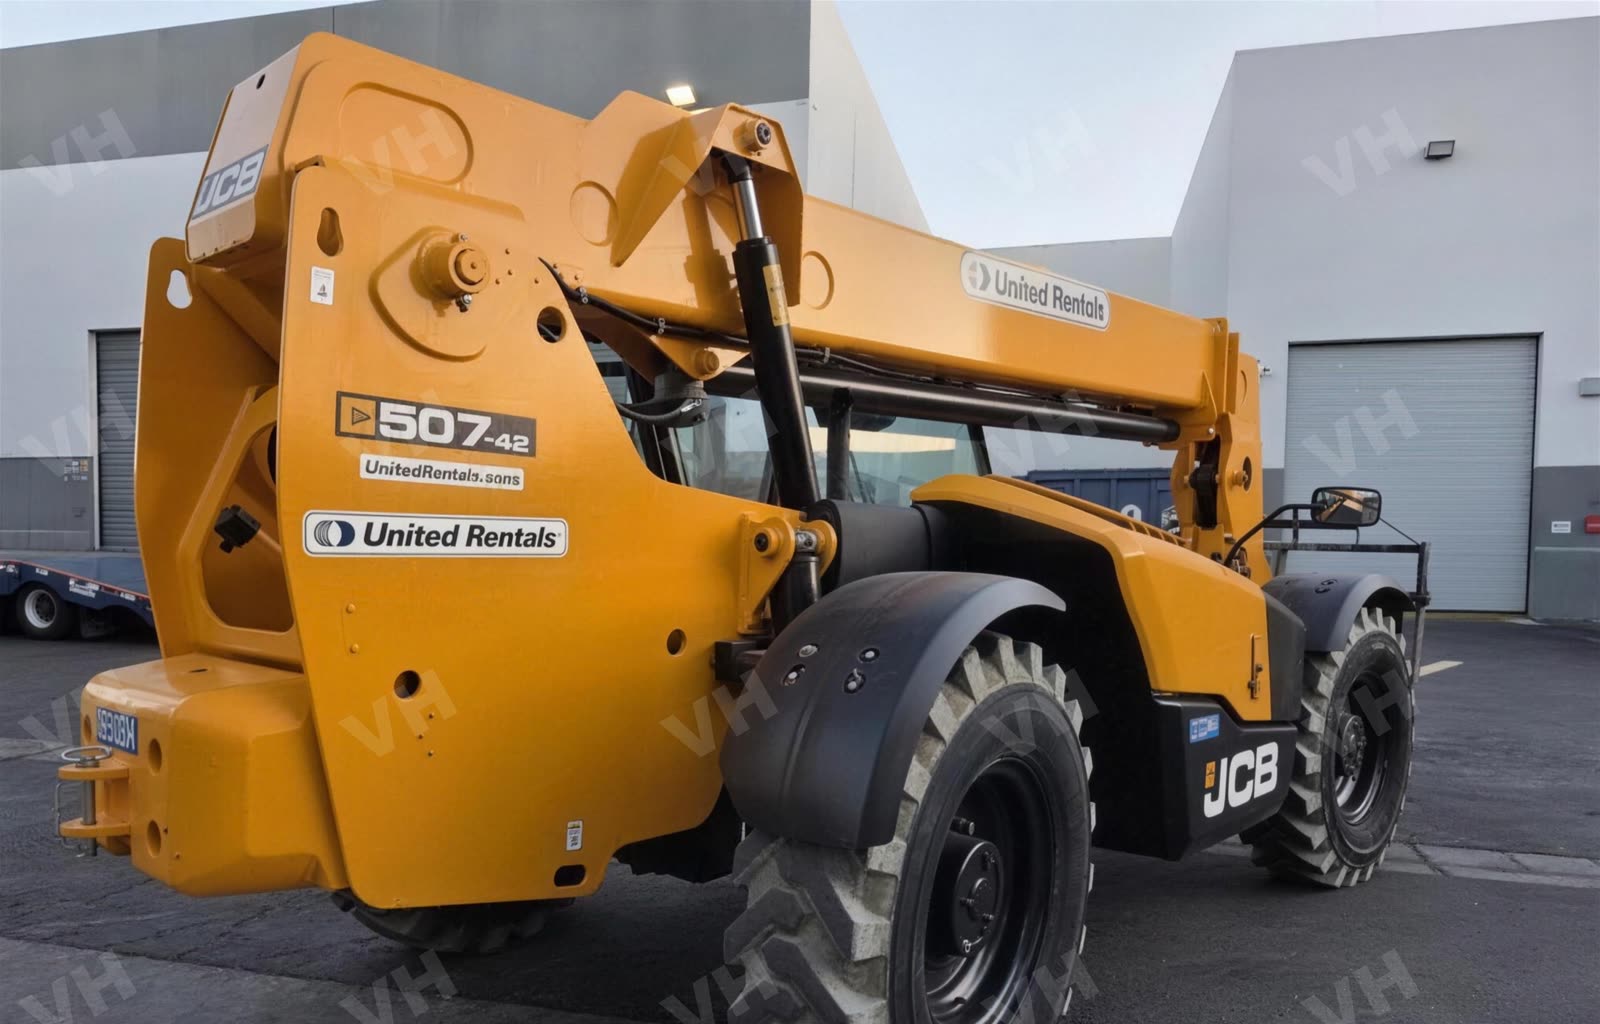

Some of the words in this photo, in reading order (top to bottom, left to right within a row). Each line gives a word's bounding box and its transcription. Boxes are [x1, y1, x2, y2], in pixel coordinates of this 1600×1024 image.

[194, 151, 265, 216] JCB
[995, 269, 1049, 306] United
[1052, 285, 1105, 321] Rentals
[379, 401, 529, 453] 507-42
[363, 522, 460, 548] United
[465, 524, 557, 548] Rentals
[1204, 741, 1278, 818] JCB
